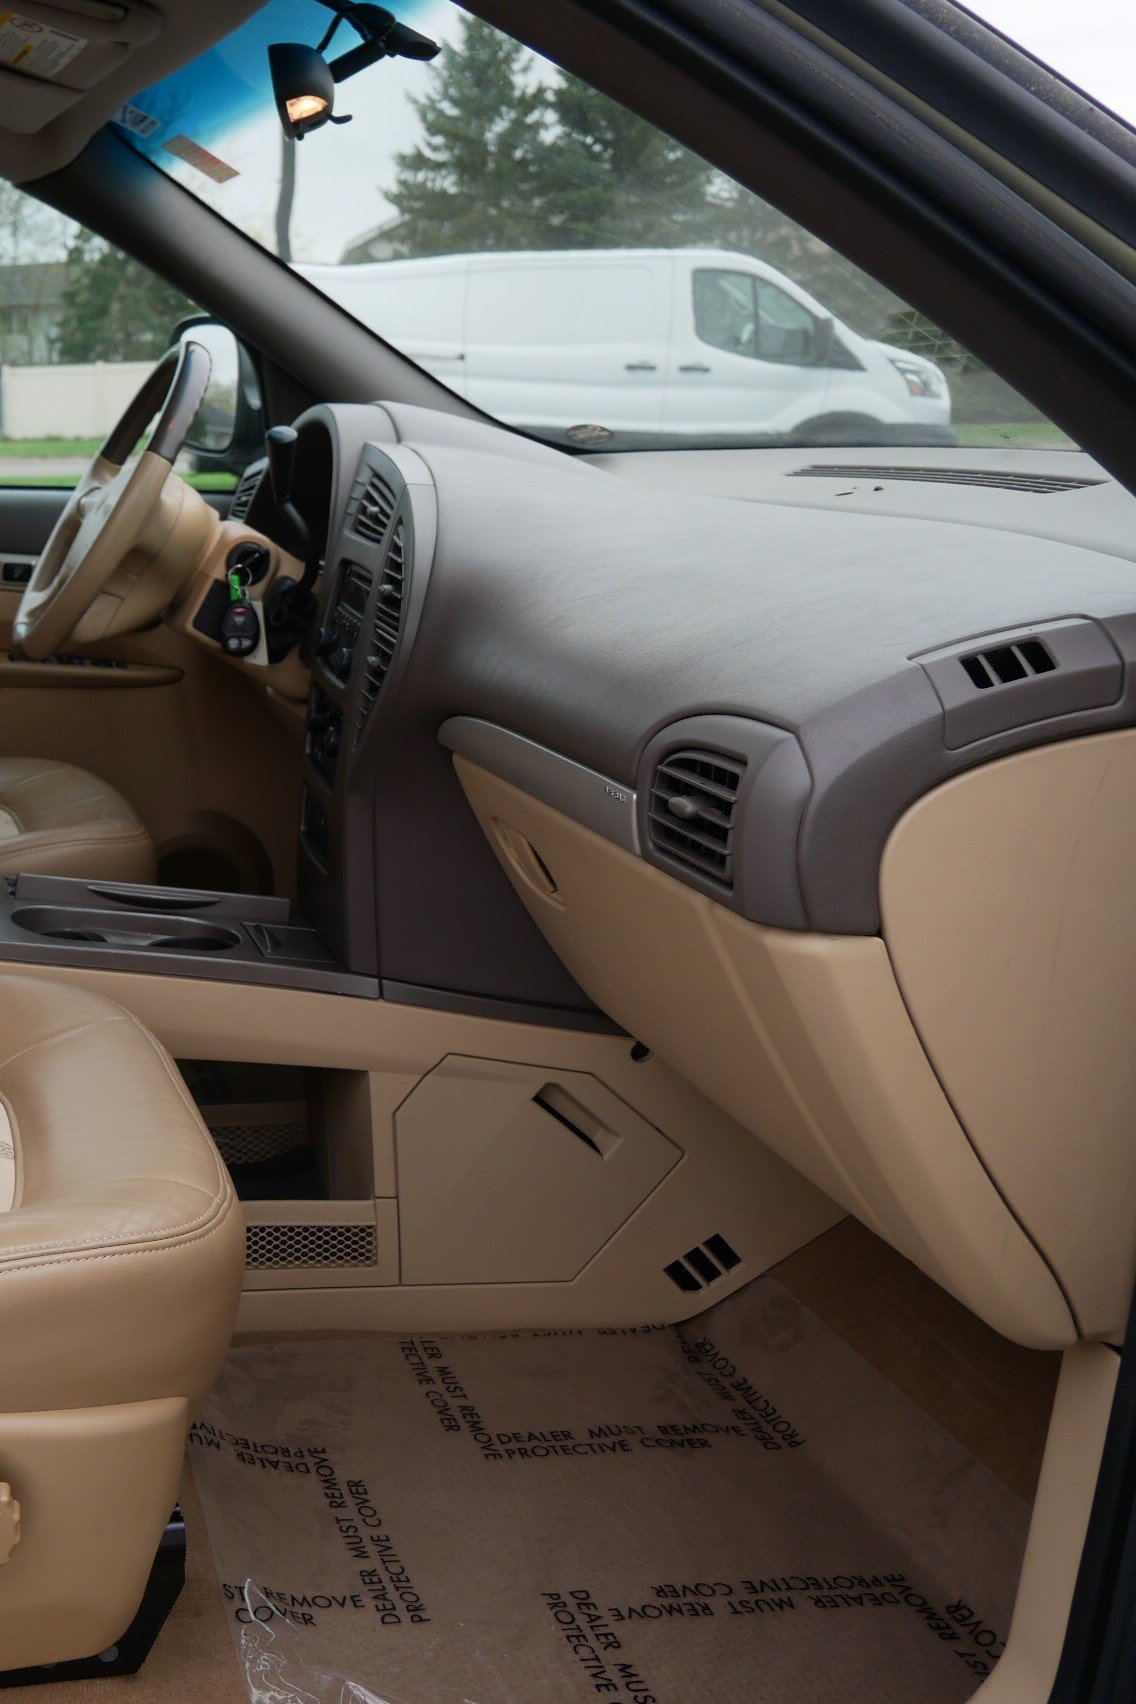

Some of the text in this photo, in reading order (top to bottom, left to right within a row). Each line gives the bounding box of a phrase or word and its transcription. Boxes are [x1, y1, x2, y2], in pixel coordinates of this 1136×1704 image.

[398, 1339, 461, 1432] TECTIVE COVER
[420, 1339, 504, 1460] LER MUST REMOVE
[496, 1422, 746, 1445] DEALER MUST REMOVE
[731, 1376, 805, 1449] PROTECTIVE
[732, 1407, 782, 1451] DEALER
[189, 1432, 311, 1474] DEALER MU
[504, 1437, 712, 1460] PROTECTIVE COVER
[308, 1446, 402, 1625] DEALER MUST REMOVE
[347, 1479, 431, 1623] PROTECTIVE COVER
[222, 1583, 365, 1609] ST REMOVE
[608, 1592, 901, 1621] DEALER MUST REMOVE
[651, 1574, 887, 1598] PROTECTIVE COVER
[235, 1605, 316, 1626] COVER
[541, 1592, 619, 1693] PROTECTIVE
[569, 1589, 657, 1704] DEALER MUS
